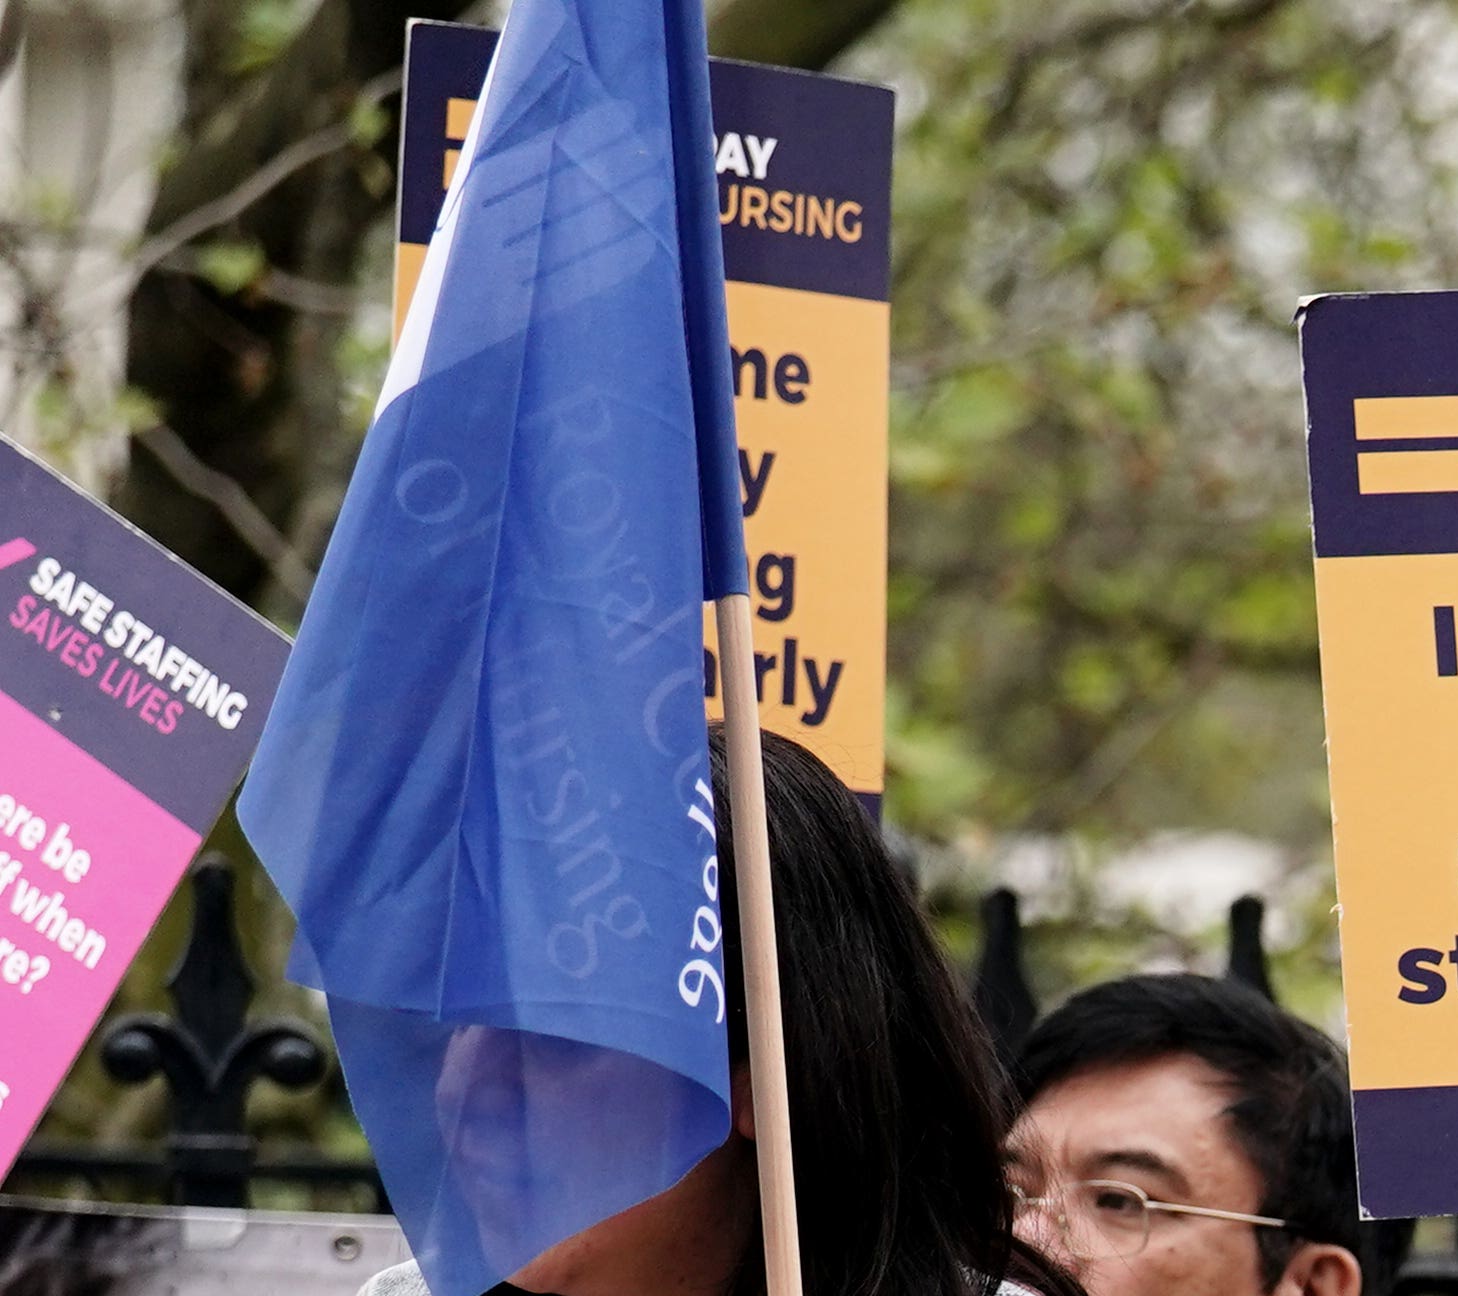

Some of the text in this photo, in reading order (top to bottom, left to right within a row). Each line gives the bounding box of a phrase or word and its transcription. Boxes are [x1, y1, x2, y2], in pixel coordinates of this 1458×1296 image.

[712, 132, 777, 179] AY
[718, 183, 863, 243] URSING
[9, 595, 184, 734] SAVES LIVES
[30, 558, 247, 729] SAFE STAFFING
[41, 823, 91, 883] be
[10, 878, 106, 969] when
